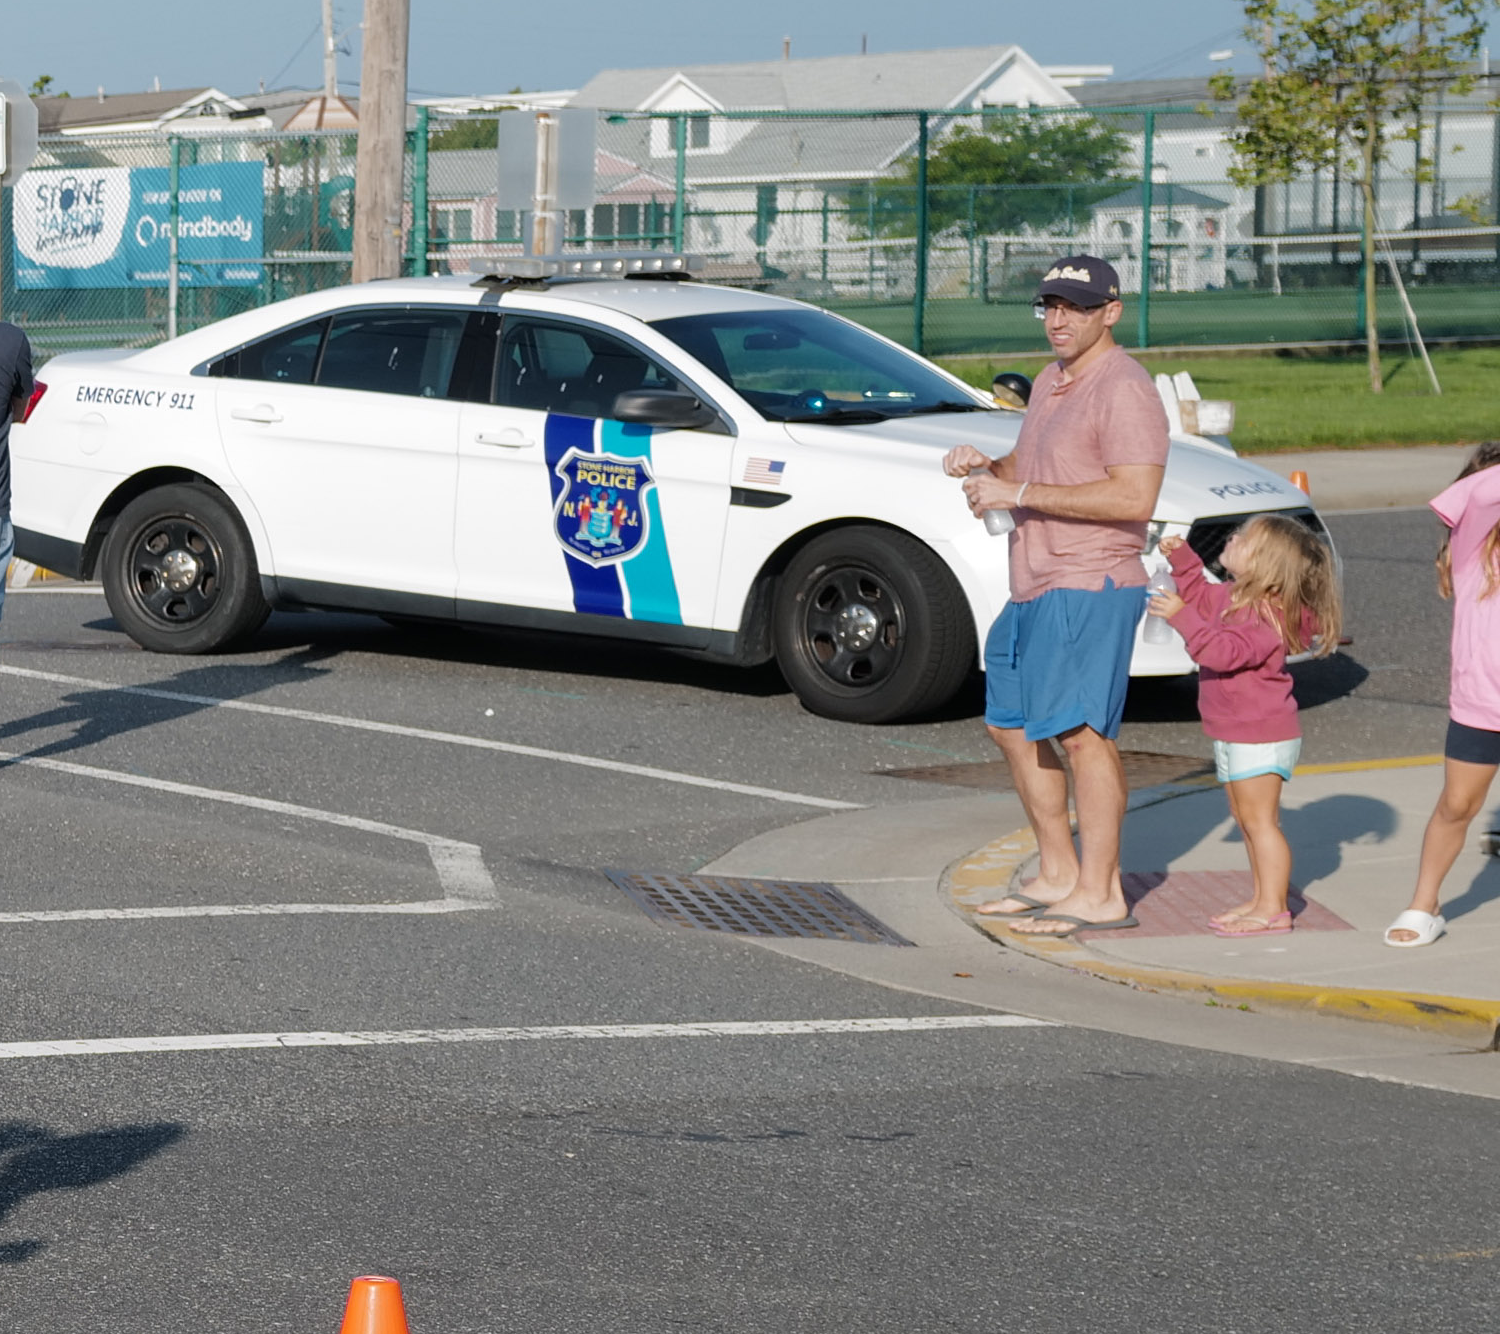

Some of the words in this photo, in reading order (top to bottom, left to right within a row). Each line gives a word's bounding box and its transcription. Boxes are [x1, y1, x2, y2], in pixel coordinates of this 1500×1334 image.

[76, 386, 166, 407] EMERGENCY
[169, 393, 195, 410] 911
[577, 470, 636, 490] POLICE
[1209, 482, 1284, 500] POLICE
